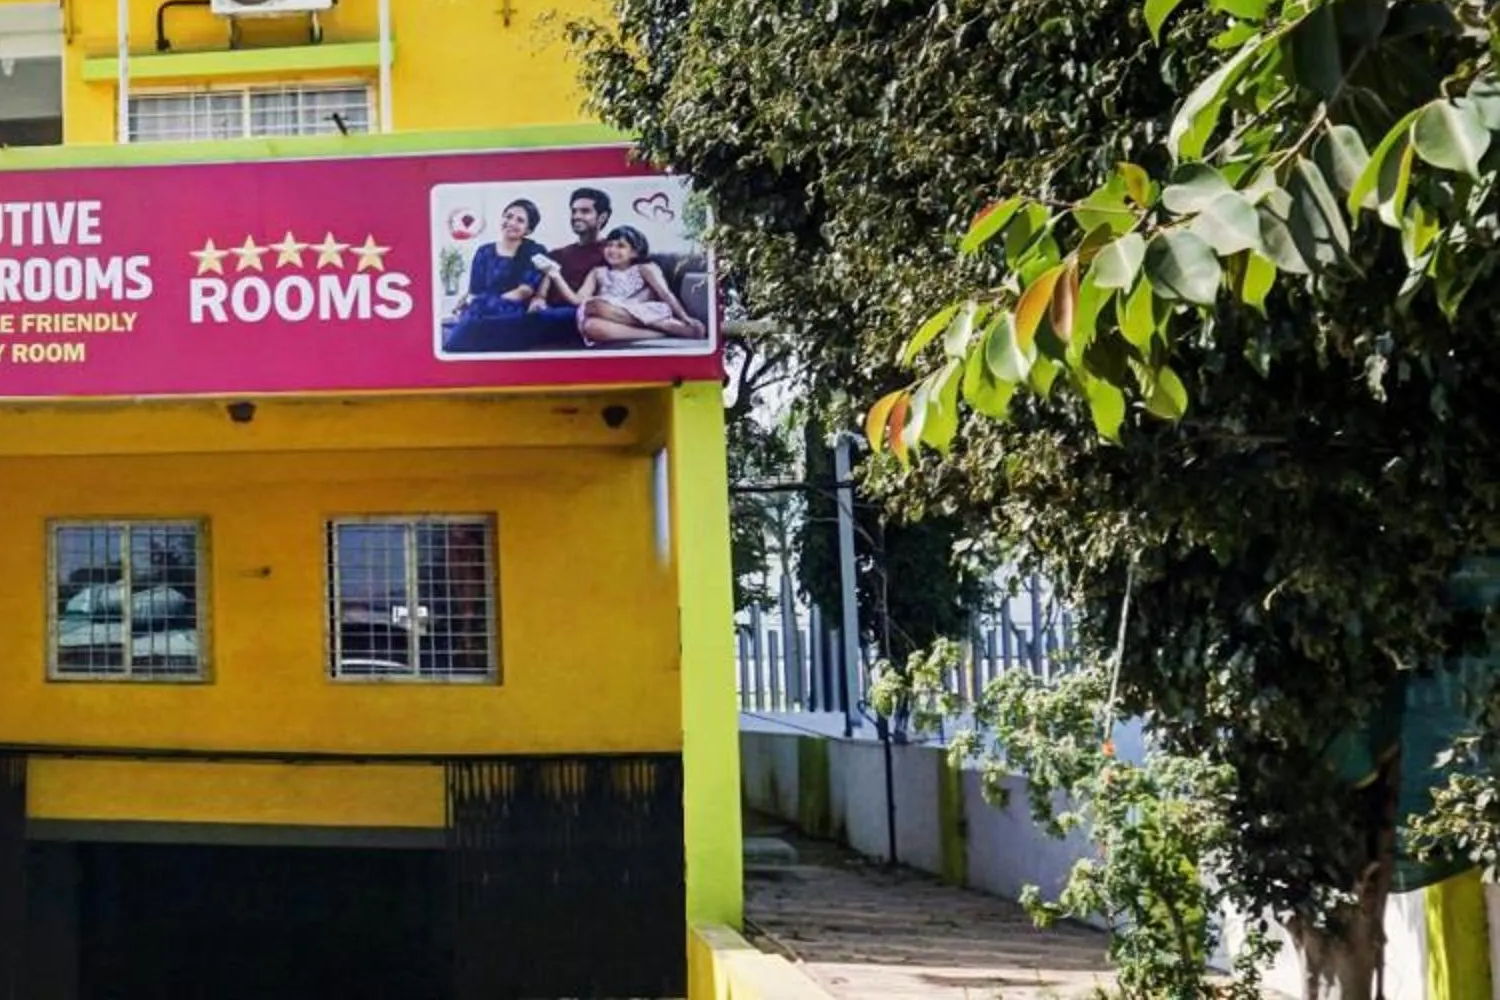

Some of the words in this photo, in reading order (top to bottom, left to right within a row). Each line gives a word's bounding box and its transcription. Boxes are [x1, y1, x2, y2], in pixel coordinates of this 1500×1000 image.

[189, 271, 414, 324] ROOMS
[21, 311, 139, 335] FRIENDLY
[11, 341, 86, 363] ROOM
